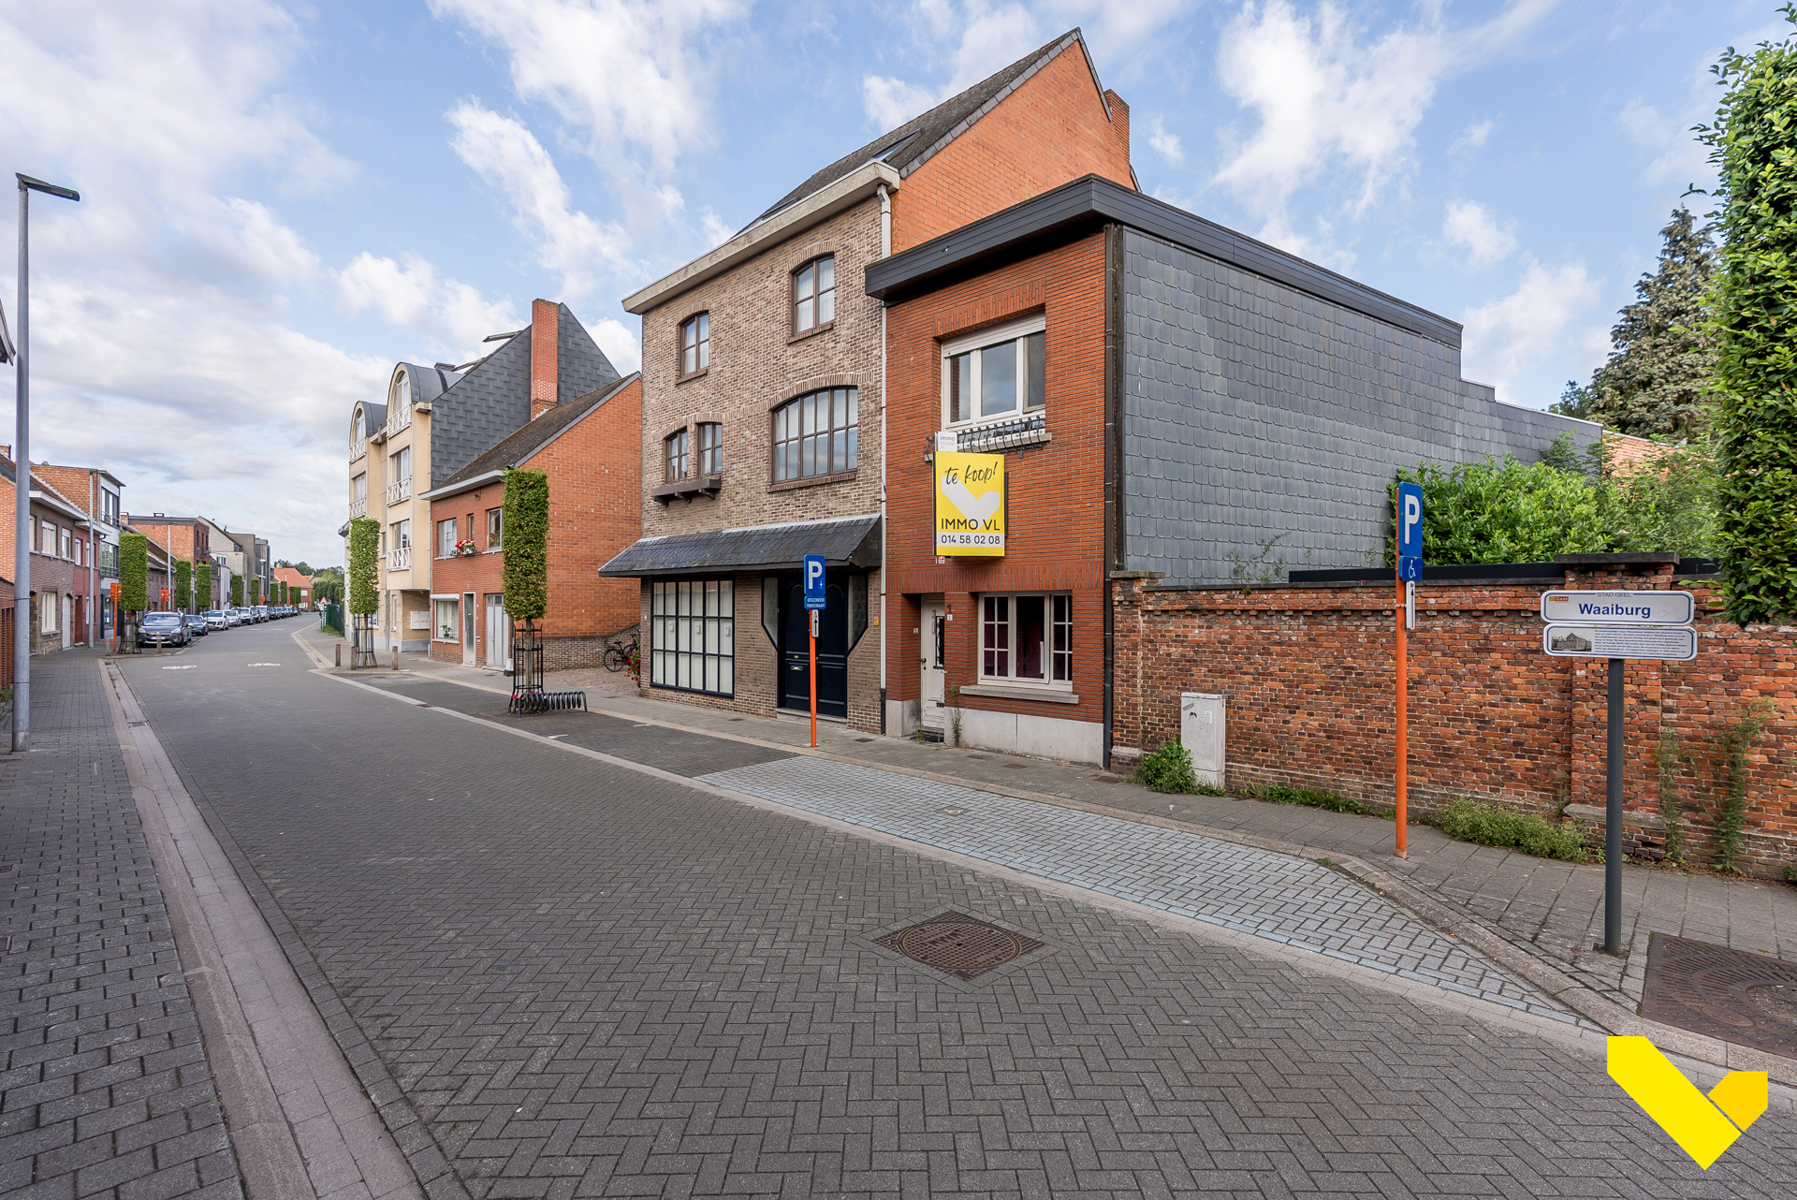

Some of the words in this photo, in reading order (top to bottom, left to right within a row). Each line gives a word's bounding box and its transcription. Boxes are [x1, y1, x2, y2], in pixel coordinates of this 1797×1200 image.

[945, 467, 959, 485] te
[964, 461, 998, 484] koop!
[941, 518, 978, 530] IMMO
[982, 519, 1000, 531] VL
[1404, 494, 1420, 544] P
[941, 535, 956, 544] 014
[959, 535, 971, 544] 58
[974, 535, 985, 544] 02
[988, 535, 1000, 544] 08
[808, 561, 823, 589] P
[1578, 603, 1651, 619] Waaiburg
